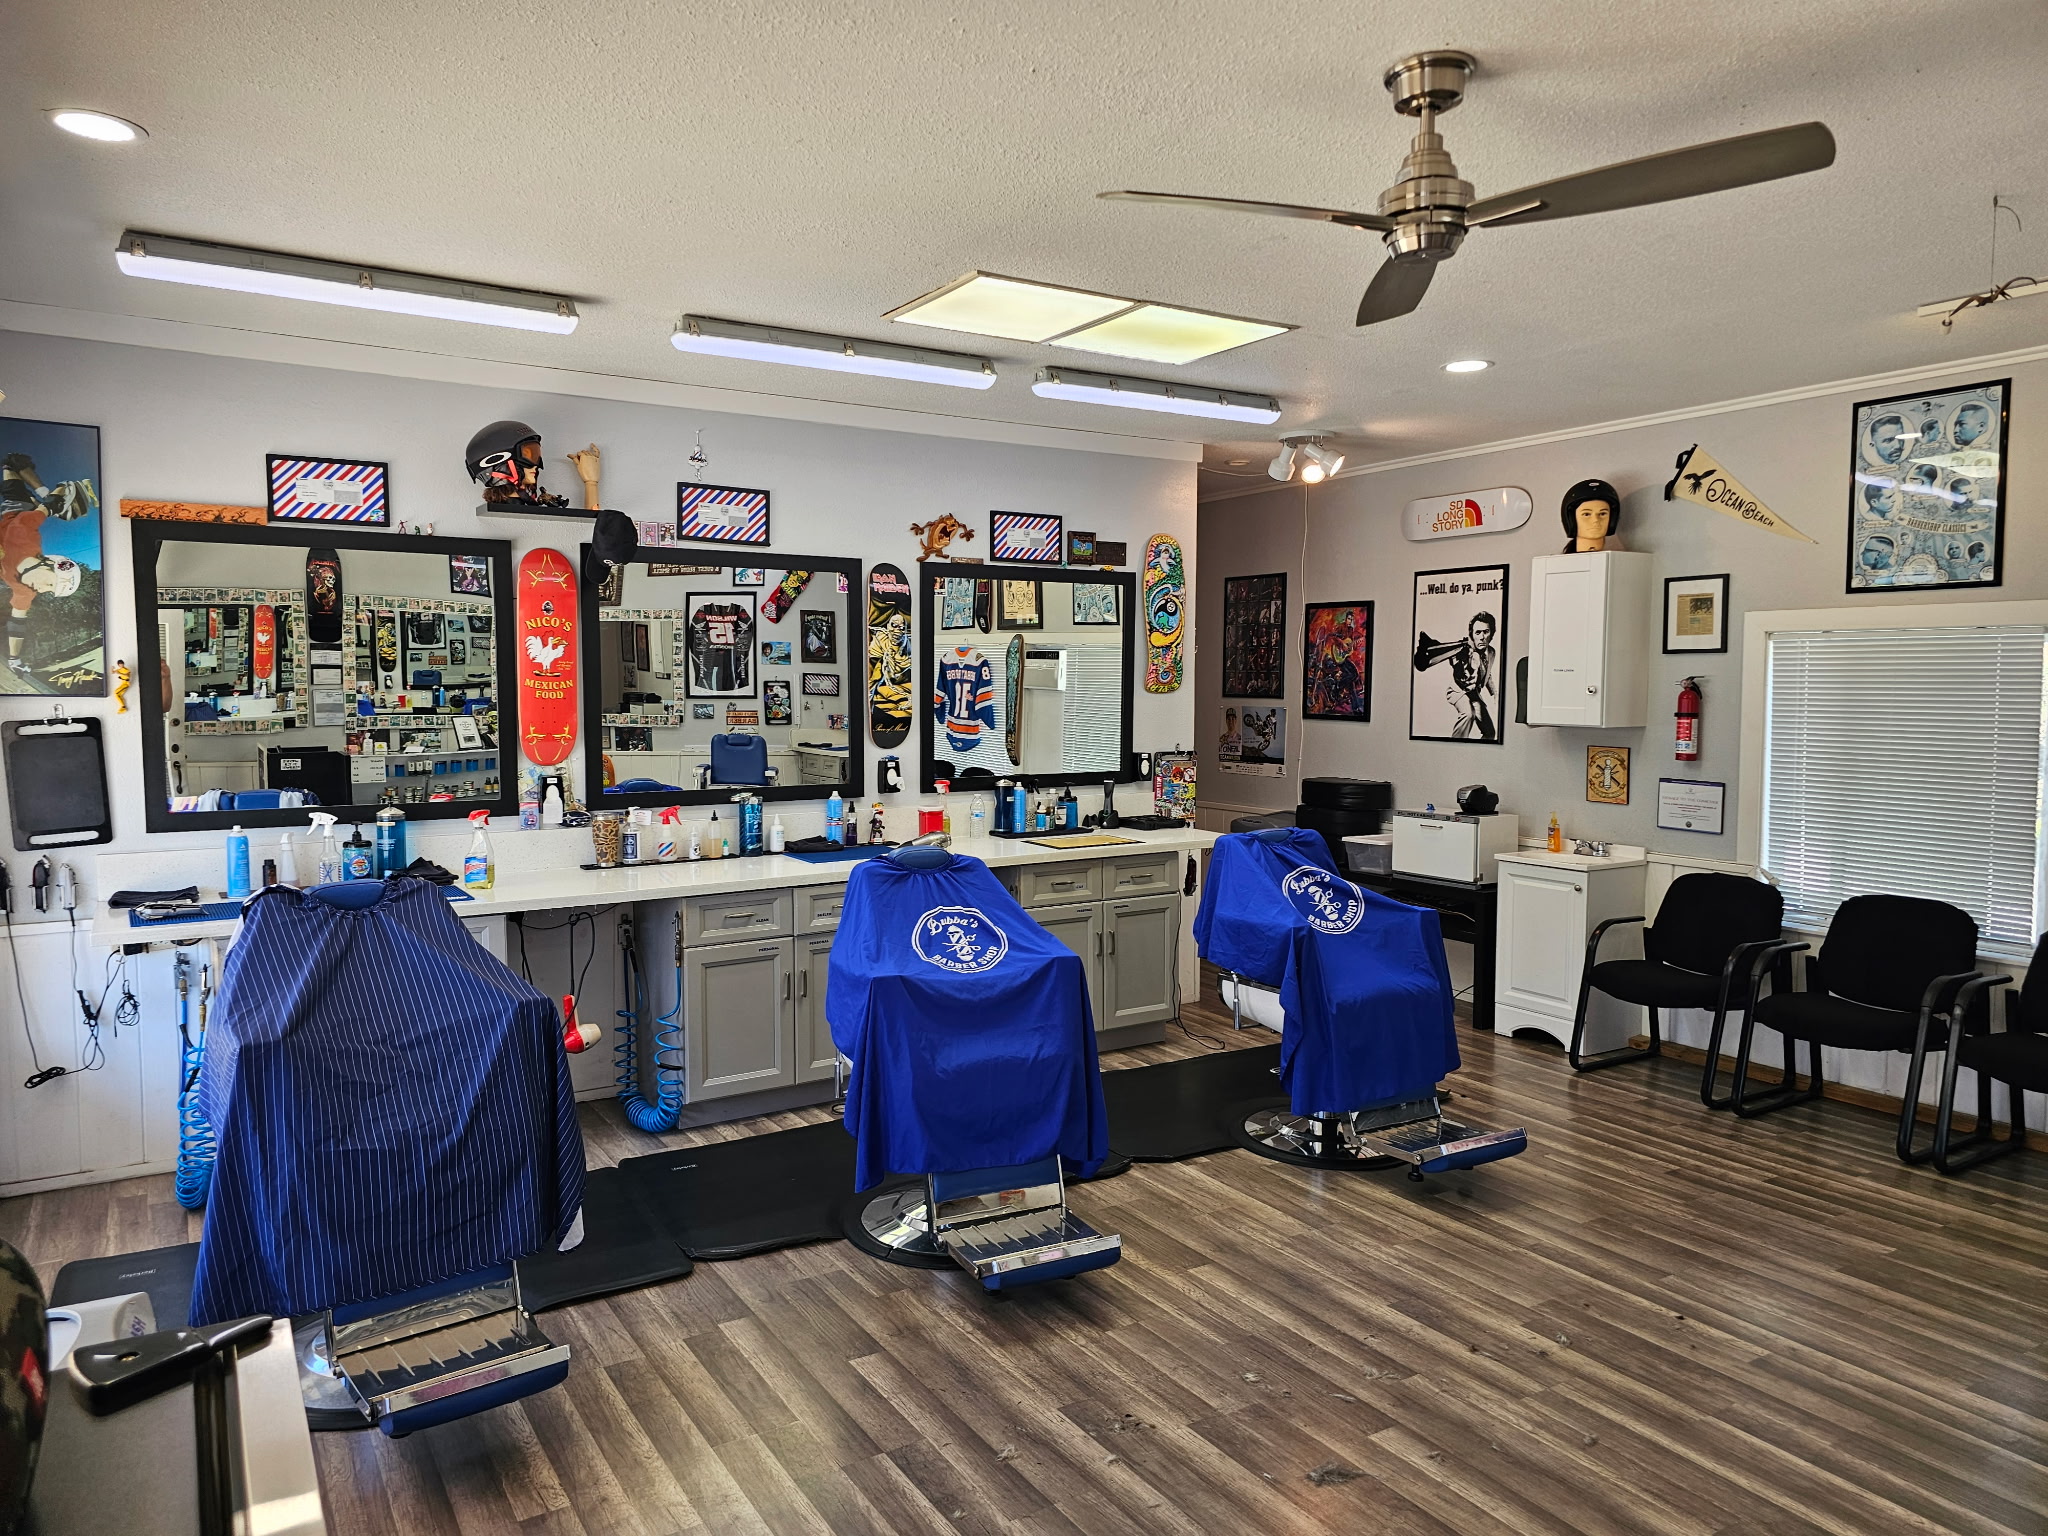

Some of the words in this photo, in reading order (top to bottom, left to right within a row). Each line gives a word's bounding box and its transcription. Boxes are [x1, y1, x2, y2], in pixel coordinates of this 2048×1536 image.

[1437, 509, 1464, 522] LONG
[1432, 519, 1464, 533] STORY
[1449, 582, 1459, 594] do
[525, 616, 573, 632] NICO'S
[524, 678, 574, 690] MEXICAN
[535, 690, 565, 699] FOOD
[1307, 914, 1345, 929] BARBER
[1341, 899, 1358, 923] SHOP
[927, 916, 979, 936] Bubba's
